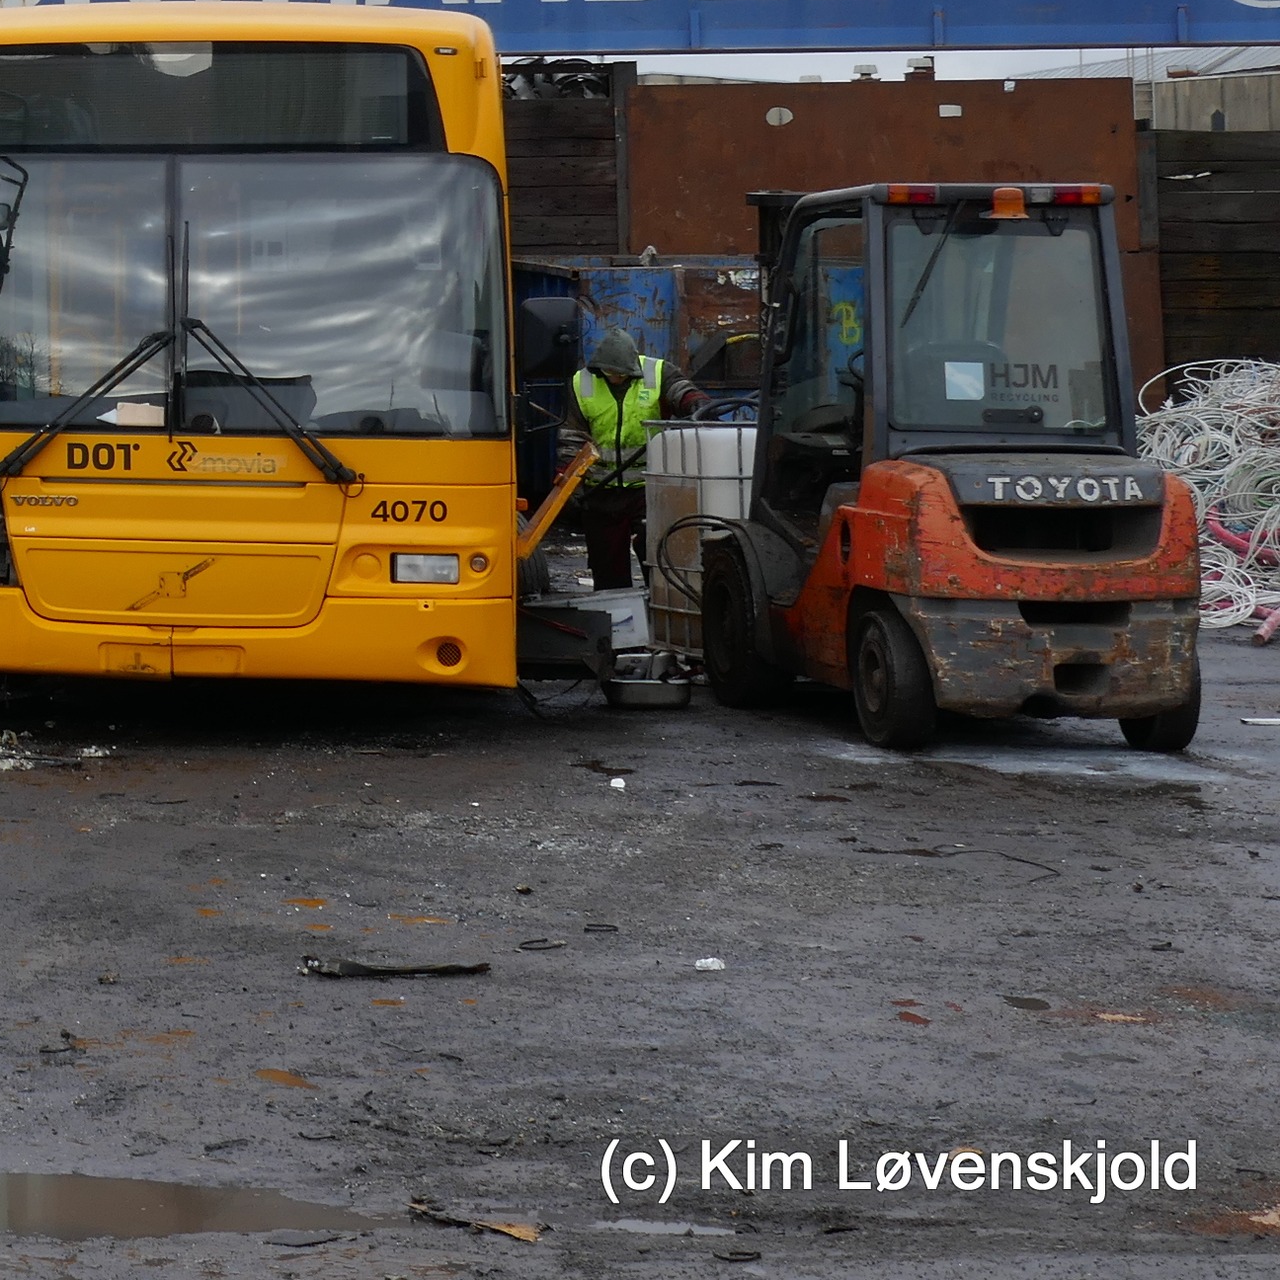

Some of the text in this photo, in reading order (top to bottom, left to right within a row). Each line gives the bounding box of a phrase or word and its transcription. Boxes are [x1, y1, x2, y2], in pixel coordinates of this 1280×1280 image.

[991, 363, 1059, 390] HJM
[991, 393, 1059, 403] RECYCLING
[67, 442, 277, 474] DOT movia
[987, 475, 1144, 502] TOYOTA
[10, 495, 79, 507] VOLVO
[371, 500, 448, 522] 4070
